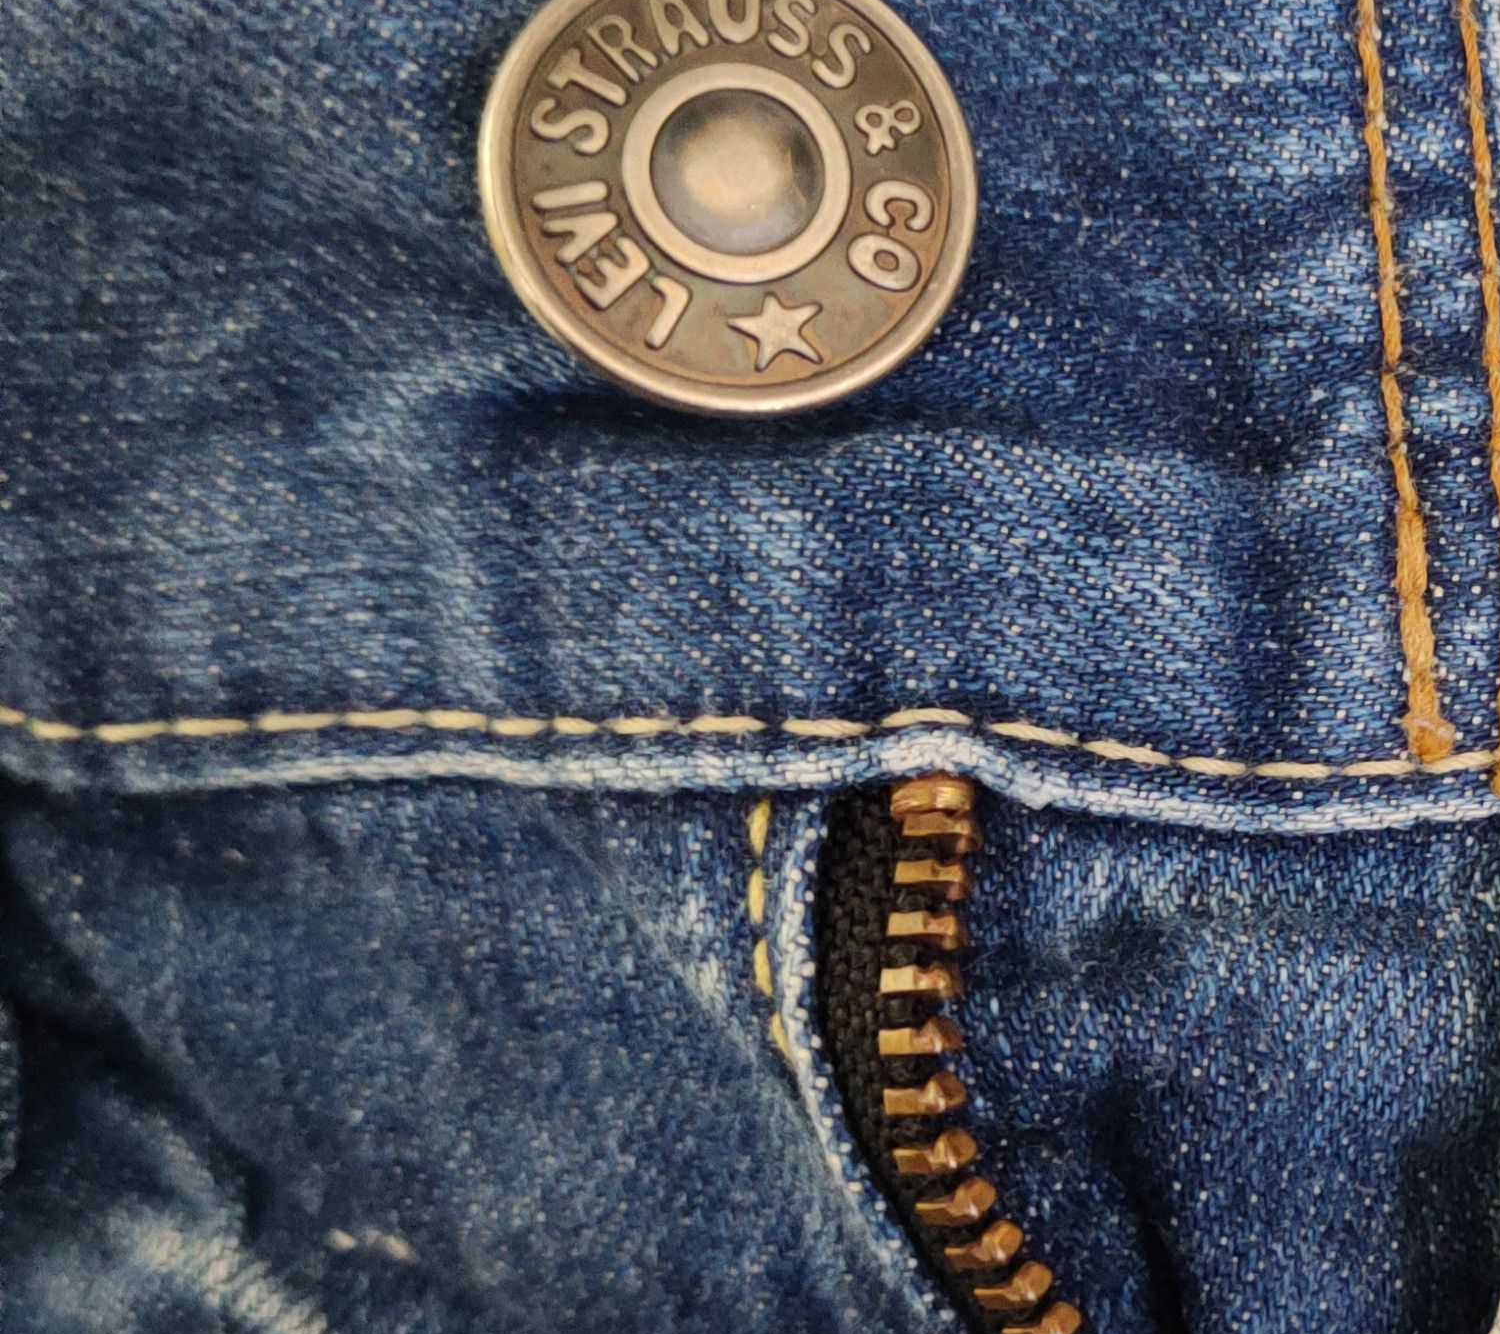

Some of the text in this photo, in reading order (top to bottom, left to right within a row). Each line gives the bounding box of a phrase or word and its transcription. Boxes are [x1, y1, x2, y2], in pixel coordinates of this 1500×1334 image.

[854, 99, 922, 156] &
[532, 180, 692, 350] LEVI
[847, 180, 934, 292] CO
